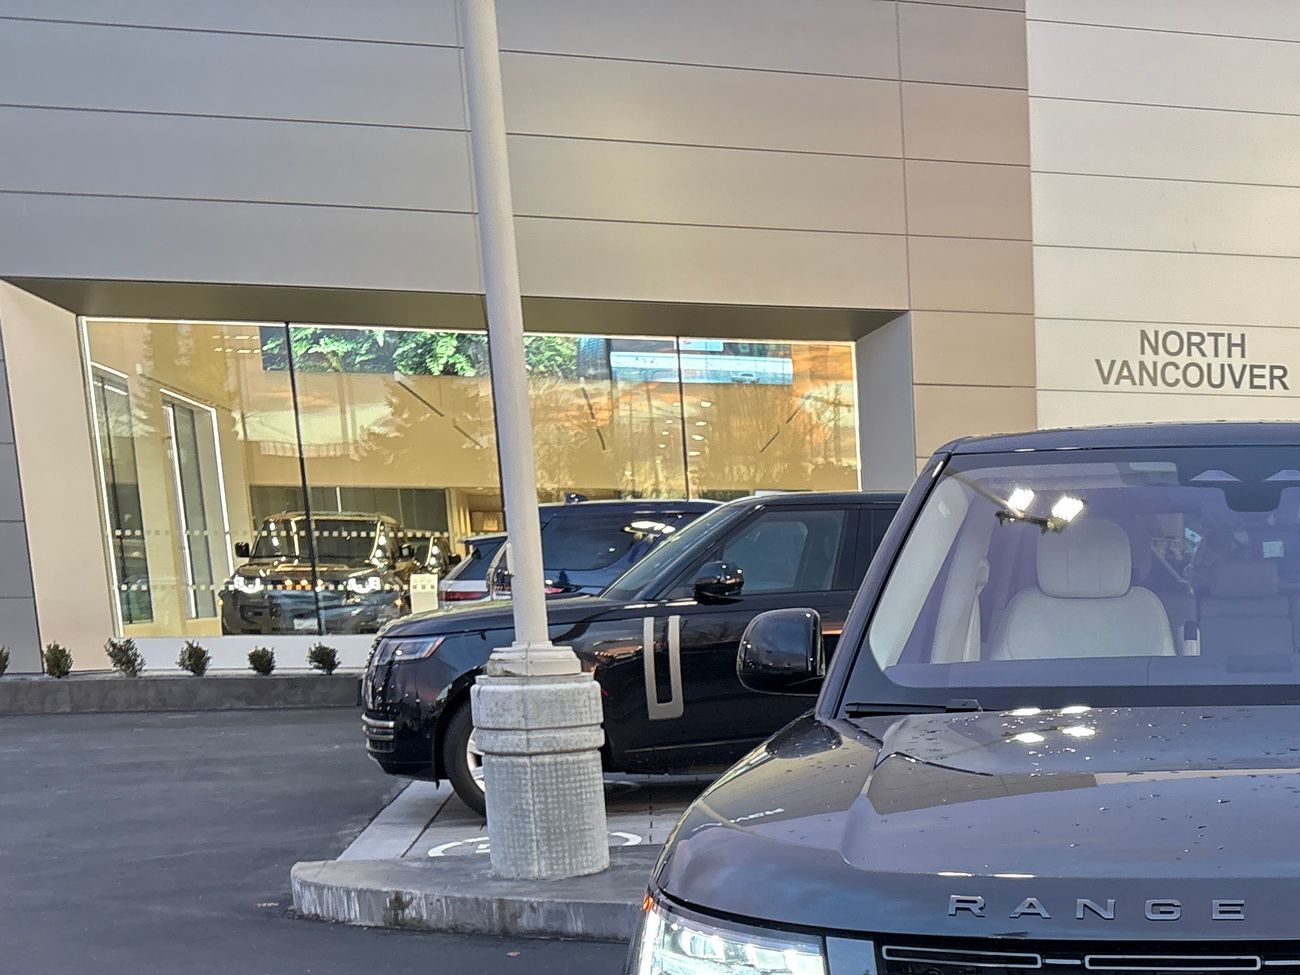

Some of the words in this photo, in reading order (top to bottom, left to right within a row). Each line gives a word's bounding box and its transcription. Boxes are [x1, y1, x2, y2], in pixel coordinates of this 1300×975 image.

[1139, 329, 1246, 358] NORTH
[1094, 358, 1290, 390] VANCOUVER
[948, 894, 1245, 920] RANGE
